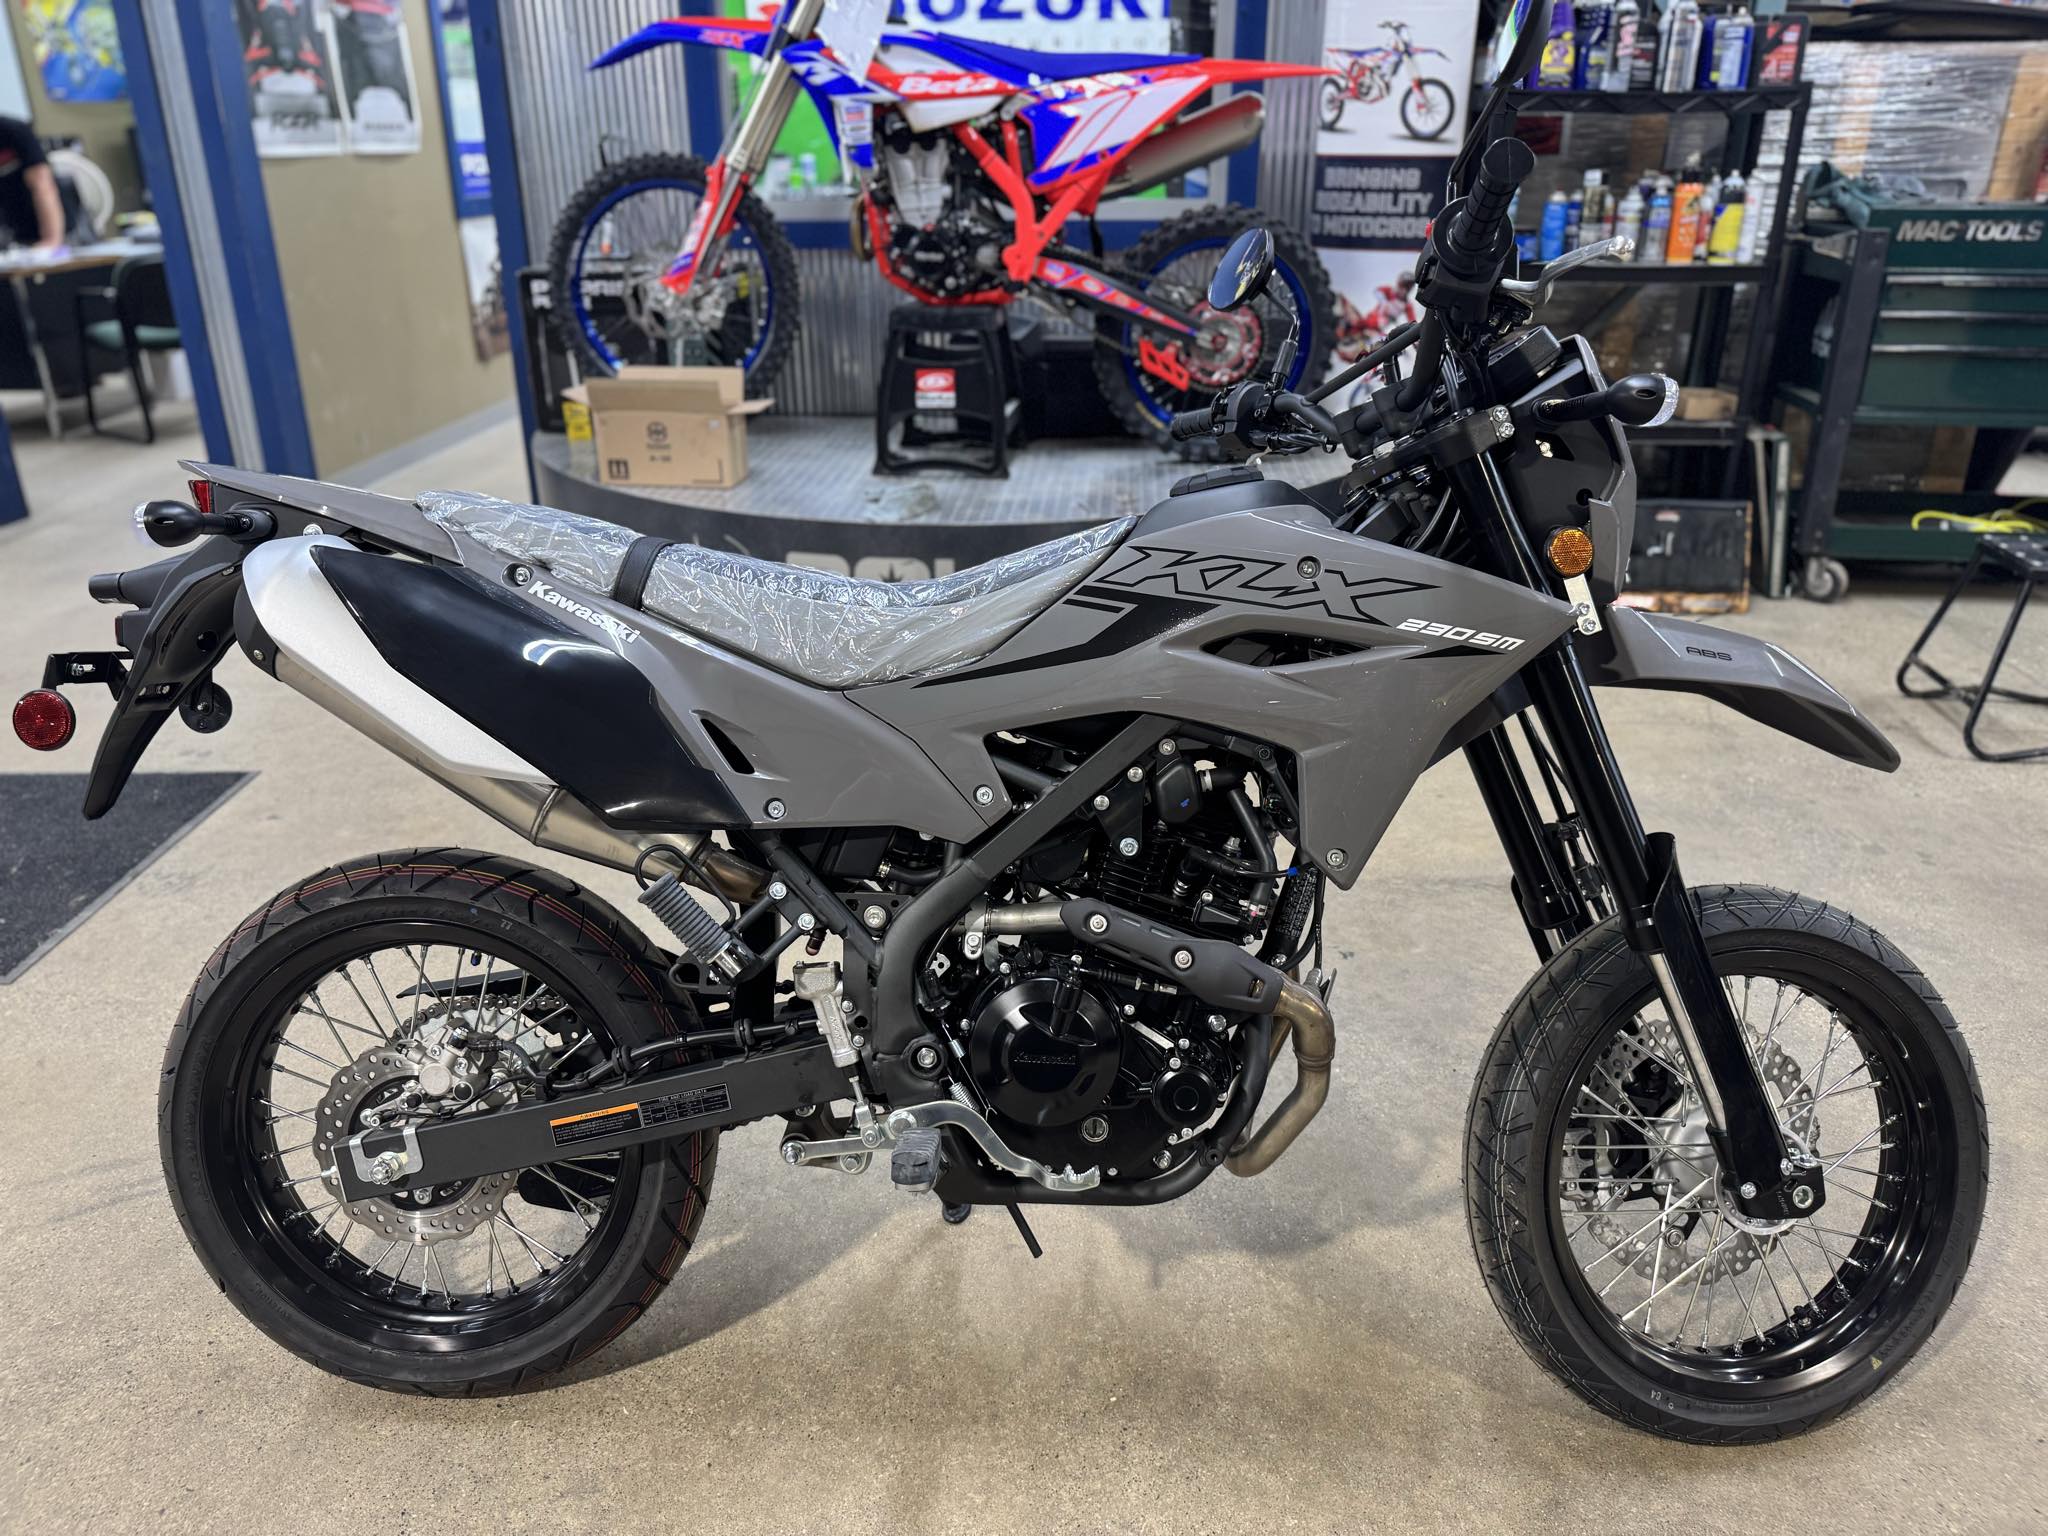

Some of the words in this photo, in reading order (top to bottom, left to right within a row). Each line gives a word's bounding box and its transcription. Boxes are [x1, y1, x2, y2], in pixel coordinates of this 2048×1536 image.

[899, 76, 999, 95] Beta
[1896, 219, 1959, 242] MAC
[1965, 218, 2044, 242] TOOLS
[1093, 546, 1442, 627] KLX
[527, 580, 641, 643] Kawasaki
[1396, 618, 1526, 651] 230SM
[1686, 646, 1732, 661] ABS
